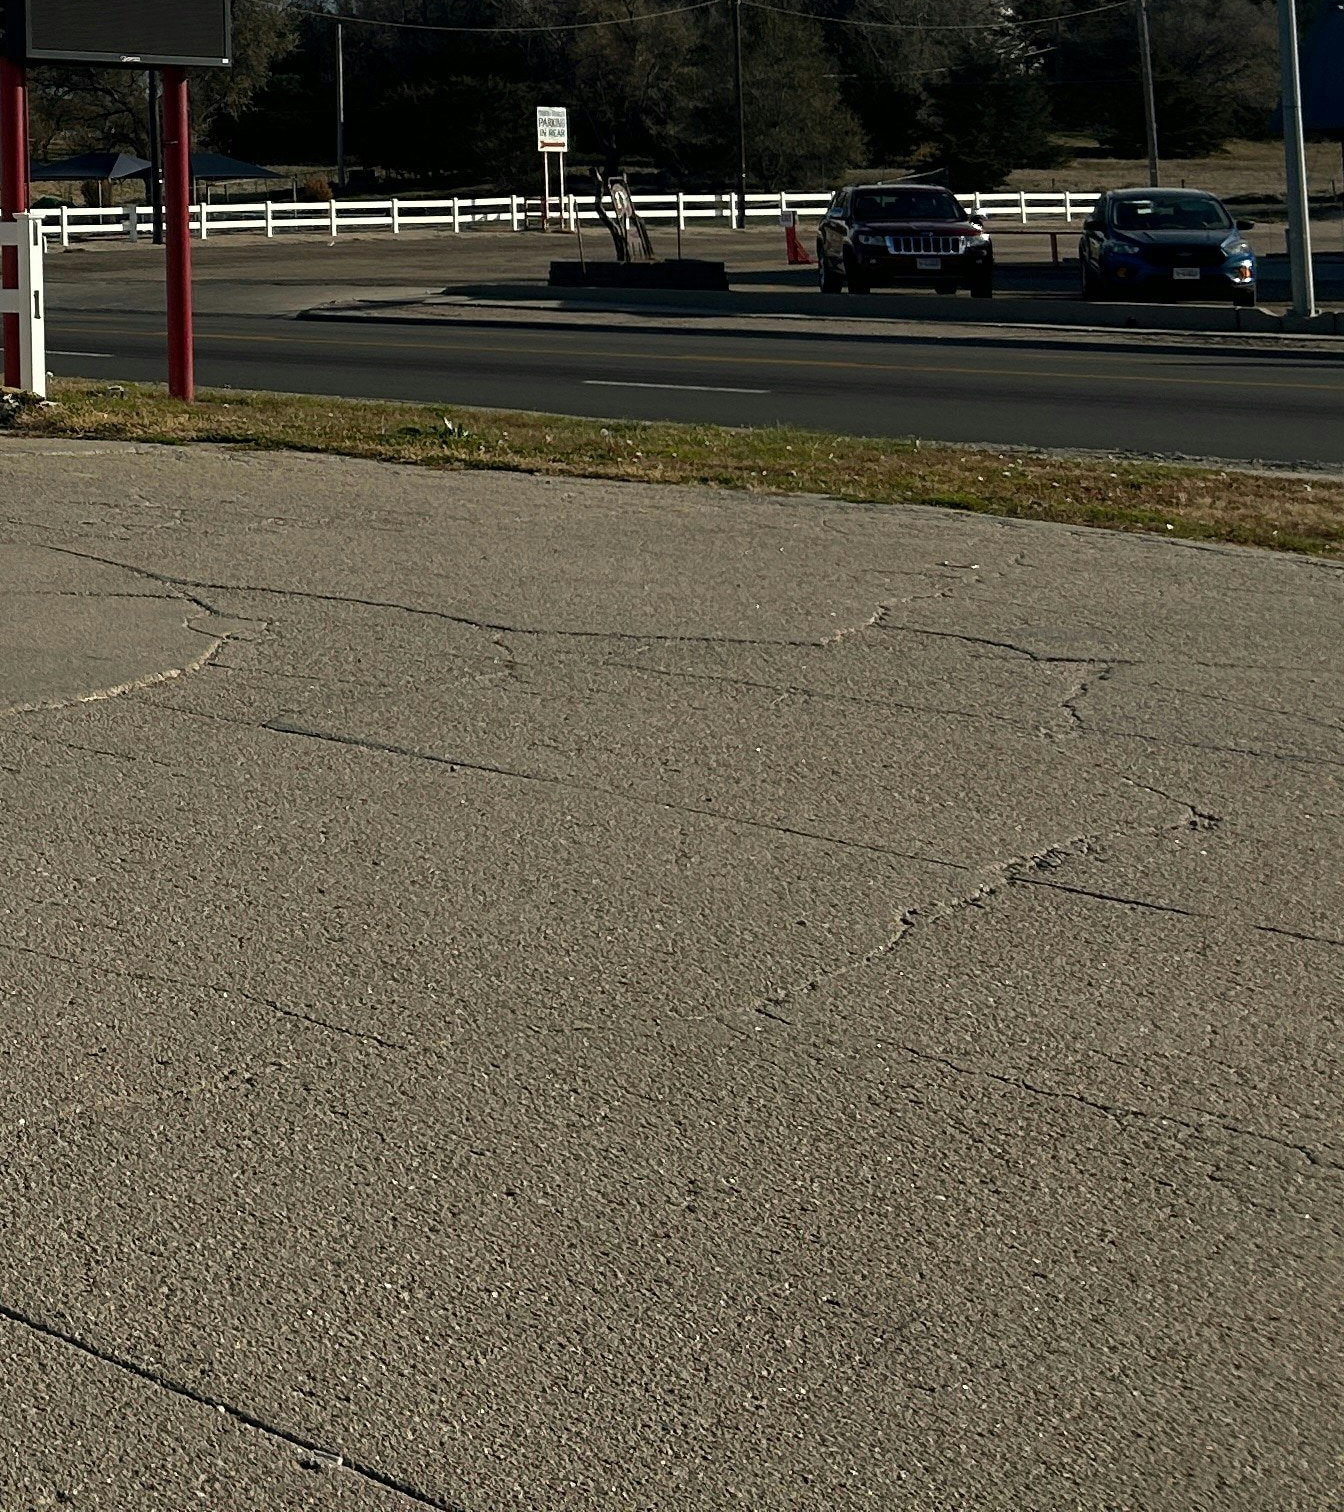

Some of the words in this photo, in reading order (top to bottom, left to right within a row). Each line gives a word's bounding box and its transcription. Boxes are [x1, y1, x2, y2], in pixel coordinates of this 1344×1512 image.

[538, 117, 565, 128] PARKING
[540, 128, 547, 137] IN
[549, 128, 565, 137] REAR
